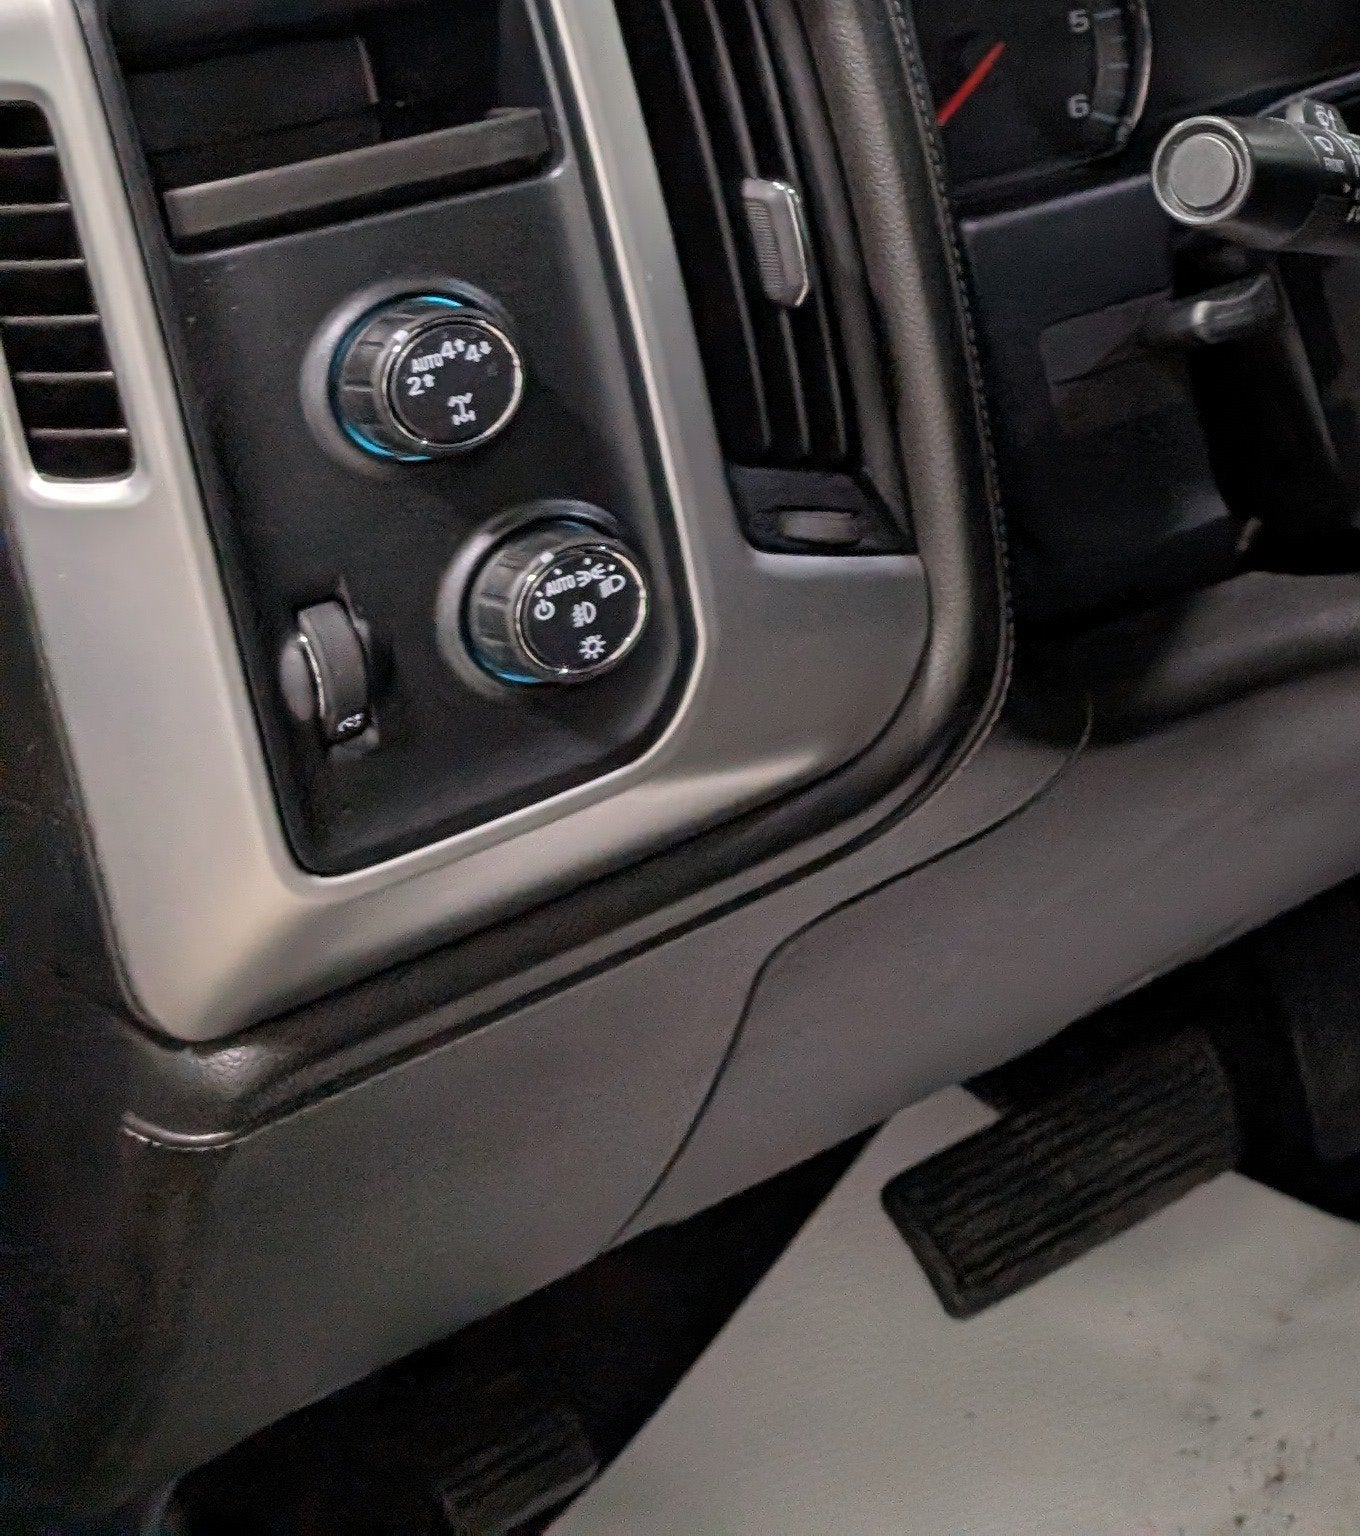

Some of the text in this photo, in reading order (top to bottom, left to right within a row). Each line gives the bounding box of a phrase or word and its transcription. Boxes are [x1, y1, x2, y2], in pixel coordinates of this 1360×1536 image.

[1068, 9, 1090, 34] 5
[1068, 93, 1090, 119] 6
[441, 340, 458, 360] 4
[465, 344, 482, 363] 4
[411, 352, 445, 374] AUTO
[406, 376, 426, 397] 2
[544, 574, 577, 598] AUTO
